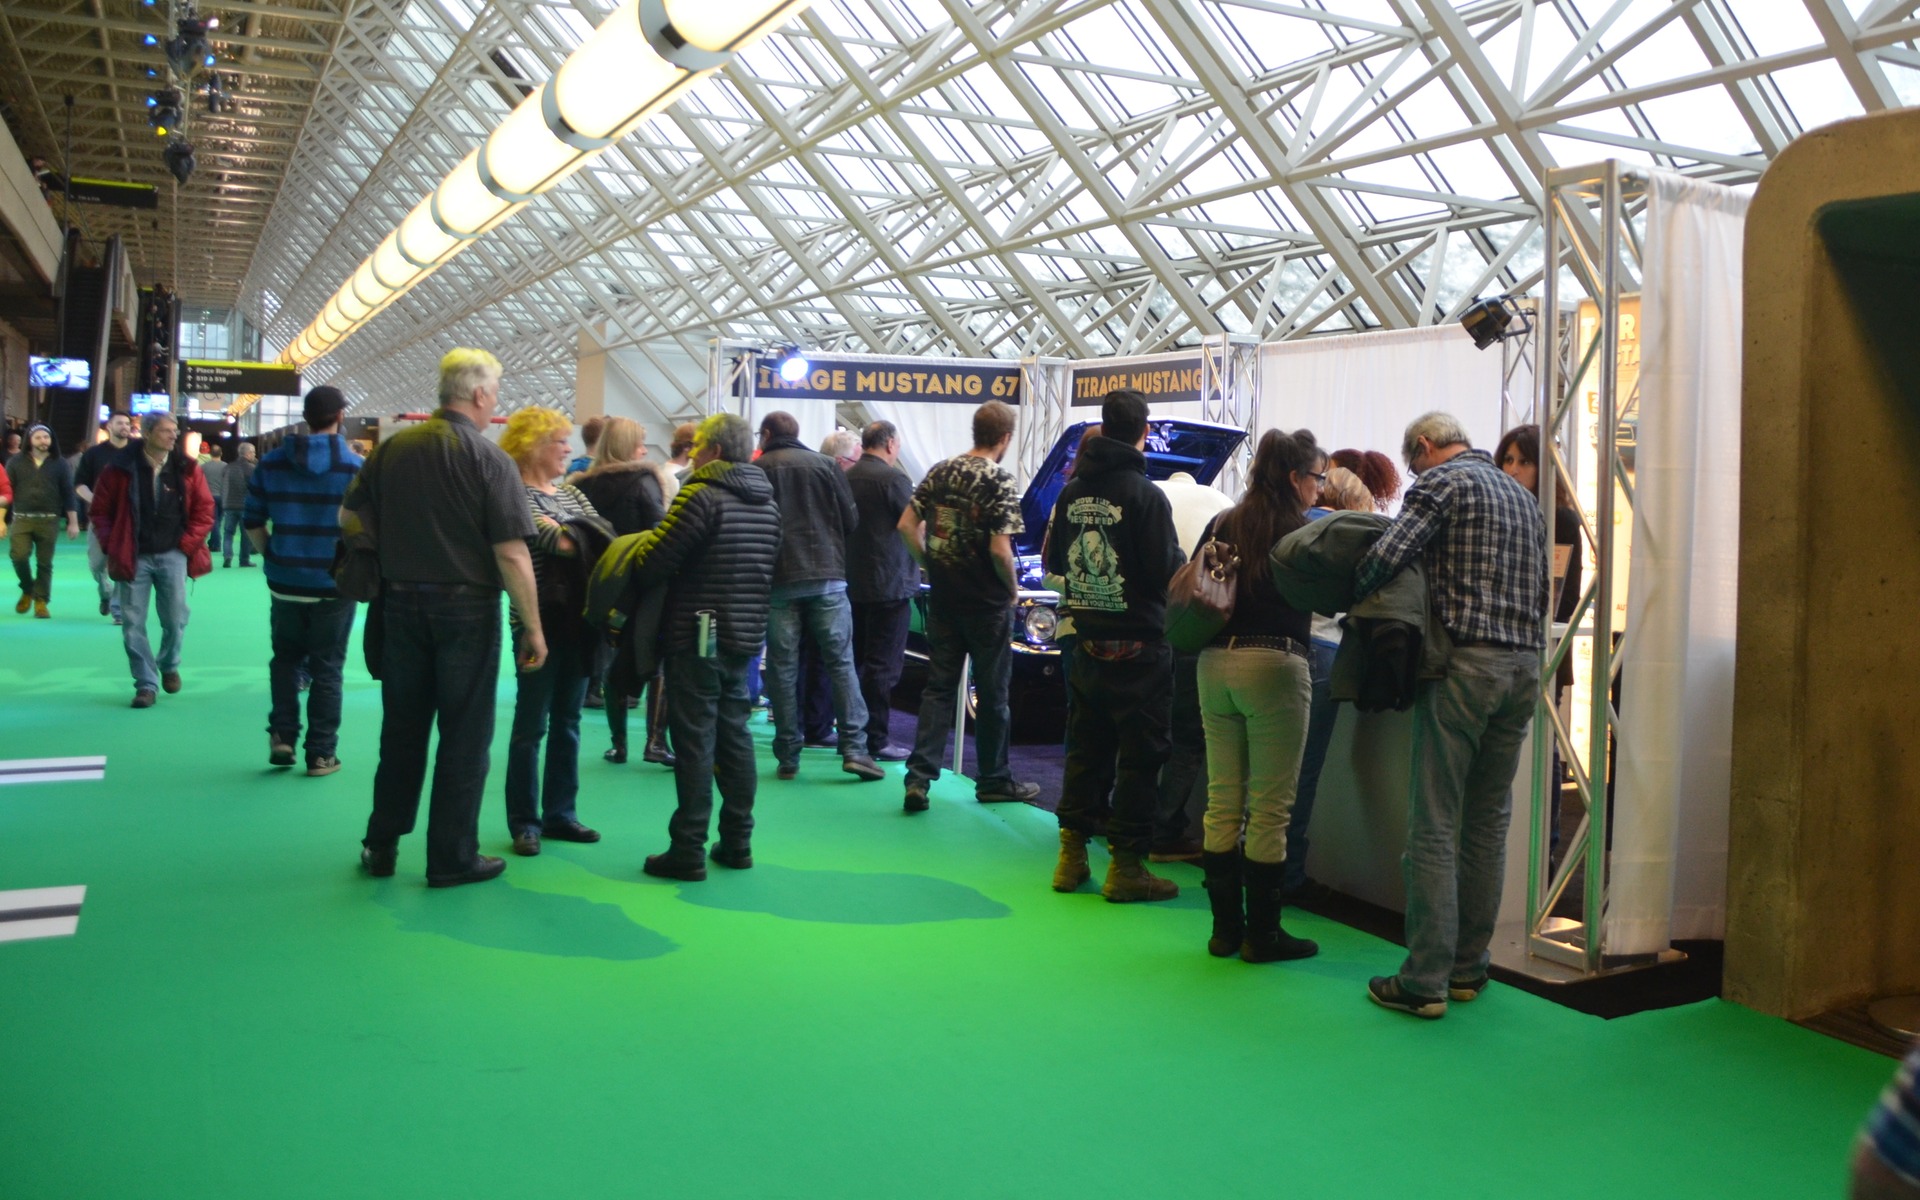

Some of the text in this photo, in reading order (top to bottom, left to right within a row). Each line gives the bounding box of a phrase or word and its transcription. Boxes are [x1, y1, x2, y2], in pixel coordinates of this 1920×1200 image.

[856, 371, 983, 396] MUSTANG
[990, 375, 1019, 397] 67
[1131, 368, 1203, 395] MUSTANG
